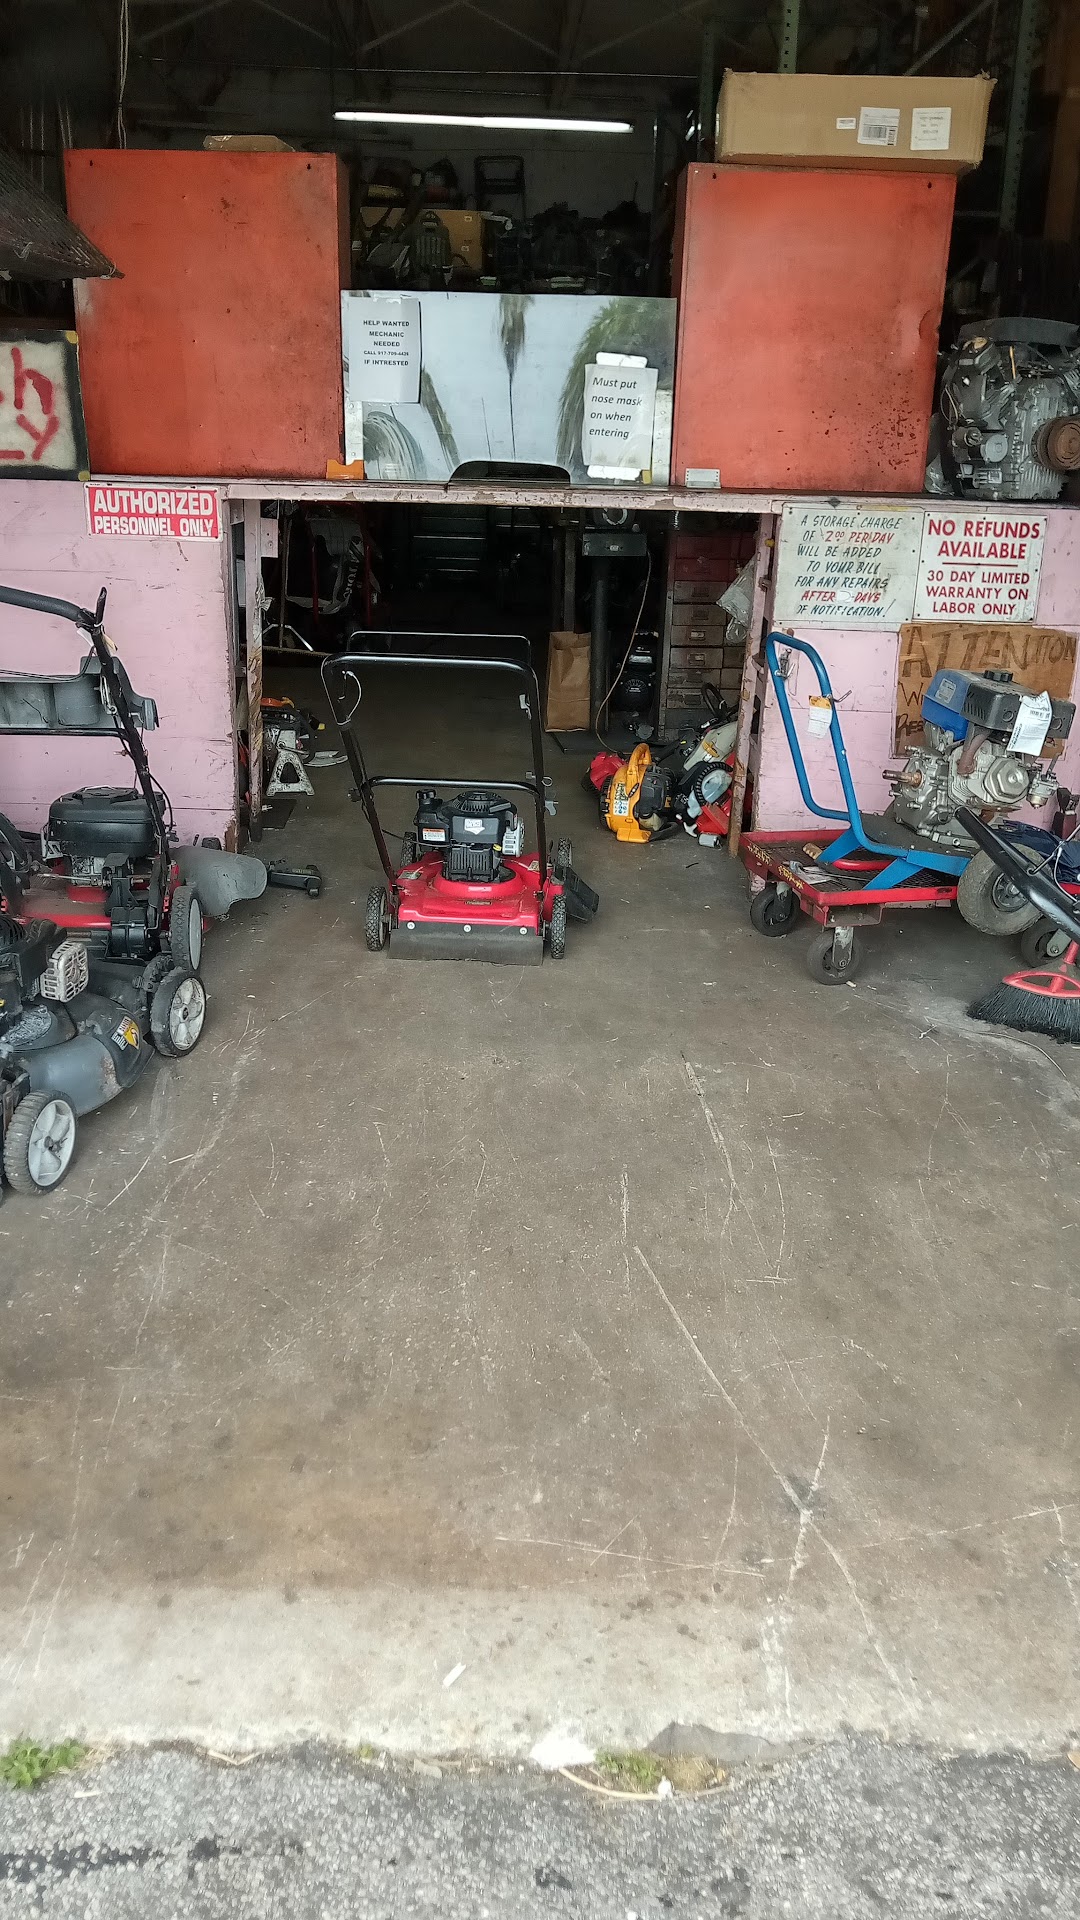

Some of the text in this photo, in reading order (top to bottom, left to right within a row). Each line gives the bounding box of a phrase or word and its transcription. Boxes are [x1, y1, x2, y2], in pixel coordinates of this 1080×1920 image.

[592, 377, 637, 390] Must put
[591, 395, 642, 406] nose mask
[605, 412, 632, 422] when
[589, 428, 629, 440] entering
[94, 489, 214, 516] AUTHORIZED
[94, 515, 214, 537] PERSONNEL ONLY
[800, 514, 903, 530] A STORAGE CHARGE
[927, 519, 1040, 539] NO REFUNDS
[802, 530, 816, 542] OF
[848, 531, 870, 543] PER
[871, 532, 895, 544] DAY
[797, 544, 882, 558] WILL BE ADDED
[937, 540, 1028, 560] AVAILABLE
[806, 560, 882, 575] TO YOUR BILL
[794, 575, 889, 589] FOR ANY REPAIRS
[927, 570, 1030, 585] 30 DAY LIMITED
[801, 590, 836, 602] AFTER
[926, 585, 1029, 600] WARRANTY ON
[932, 601, 1017, 616] LABOR ONLY
